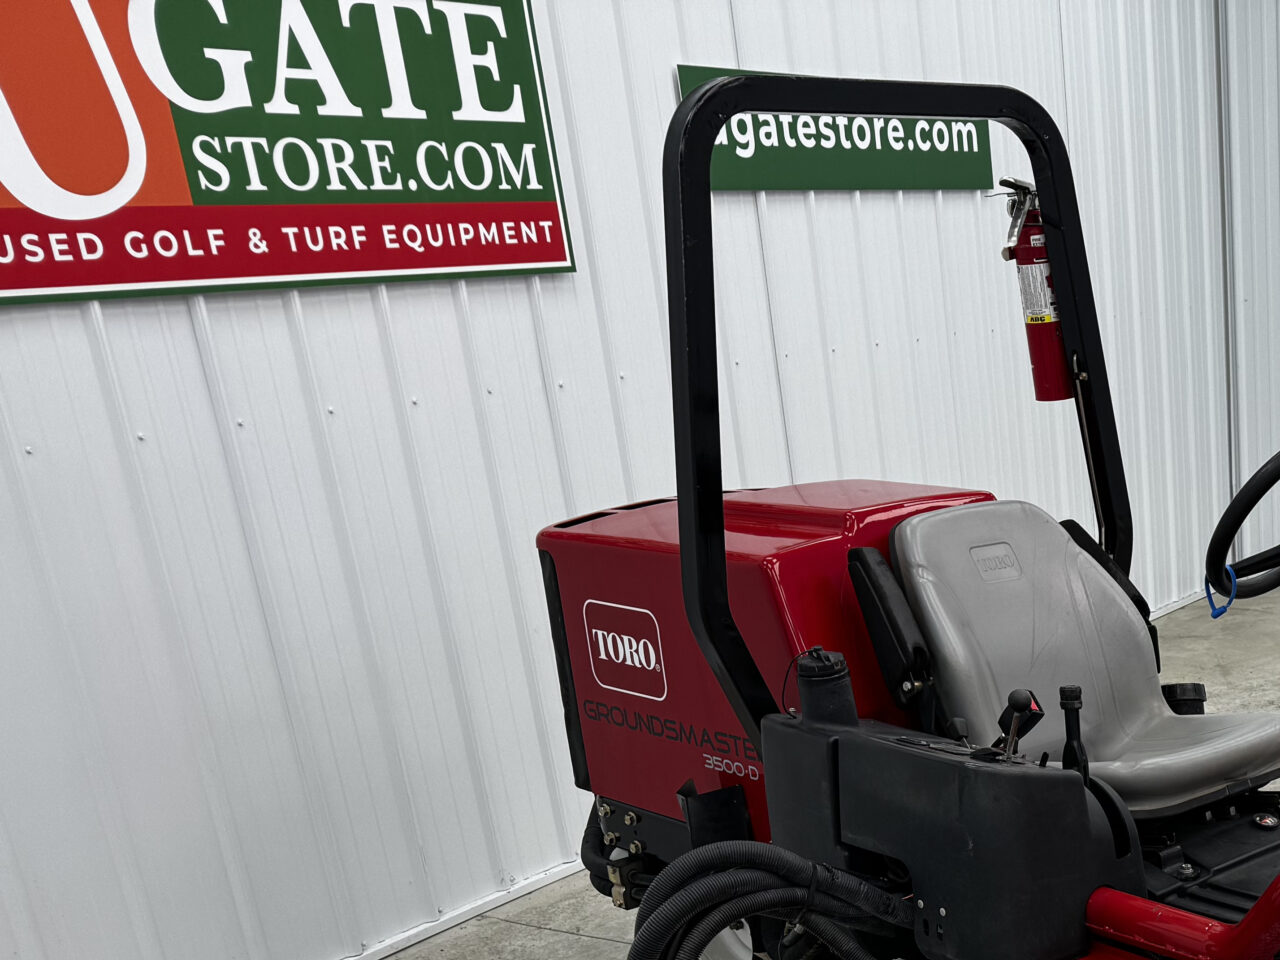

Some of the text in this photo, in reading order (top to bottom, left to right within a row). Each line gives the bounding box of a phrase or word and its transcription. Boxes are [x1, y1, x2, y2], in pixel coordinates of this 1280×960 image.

[192, 135, 543, 191] STORE.COM
[124, 228, 225, 258] GOLF
[248, 228, 268, 253] &
[281, 226, 367, 252] TURF
[382, 221, 553, 250] EQUIPMENT
